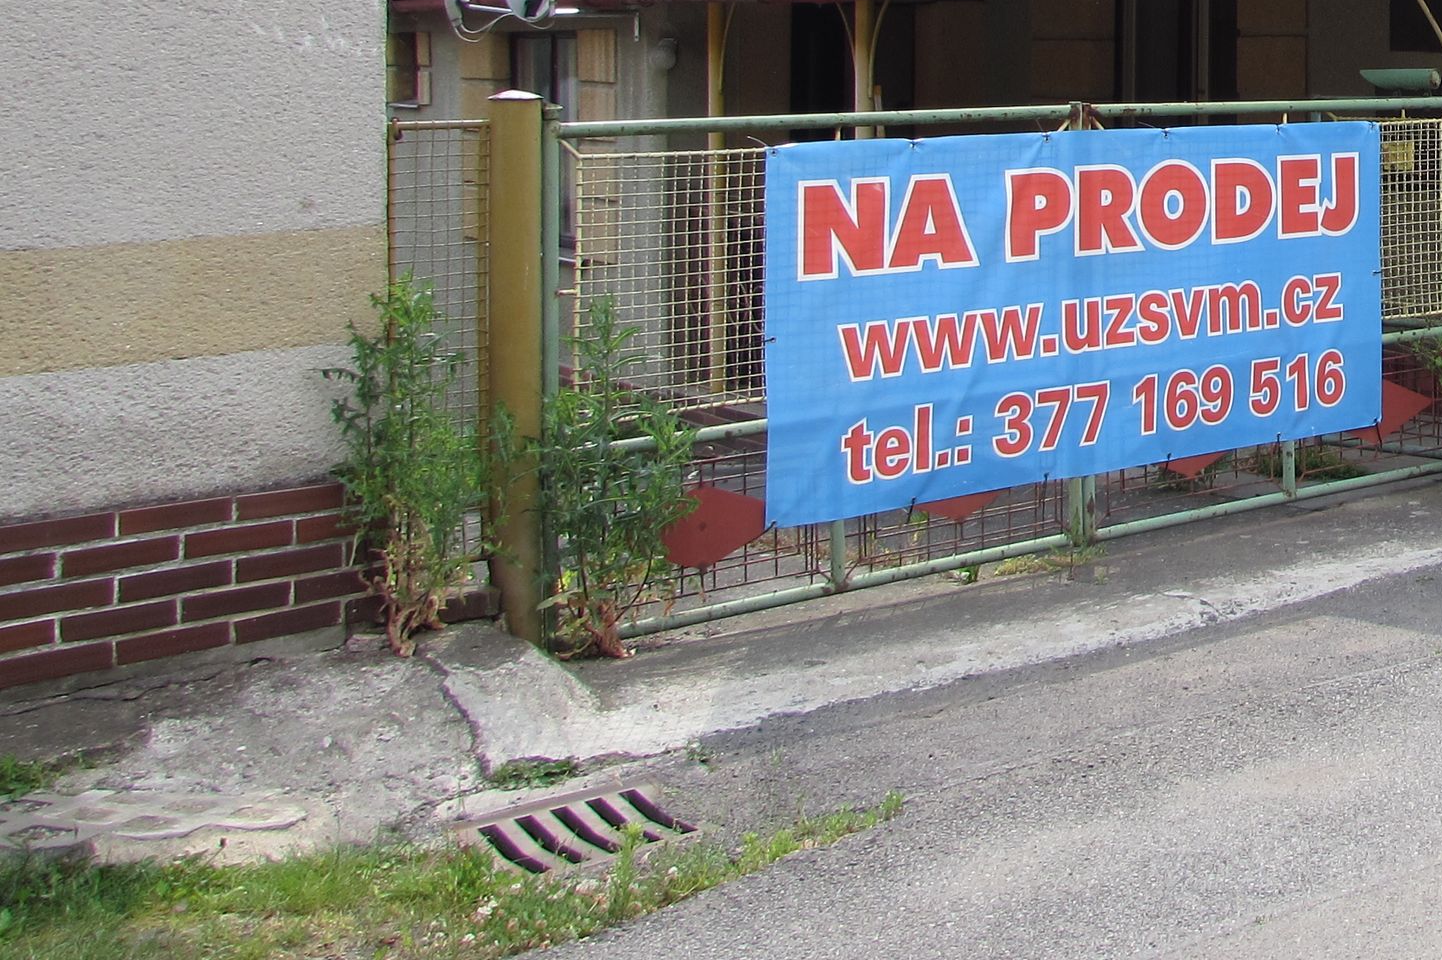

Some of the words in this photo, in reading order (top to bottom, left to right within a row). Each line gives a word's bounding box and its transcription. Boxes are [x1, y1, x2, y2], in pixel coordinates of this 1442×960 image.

[796, 172, 980, 282] NA
[1004, 151, 1361, 264] PRODEJ
[837, 271, 1344, 382] www.uzsvm.cz
[840, 402, 974, 485] tel.:
[991, 379, 1111, 457] 377
[1131, 364, 1236, 436] 169
[1248, 348, 1346, 418] 516
